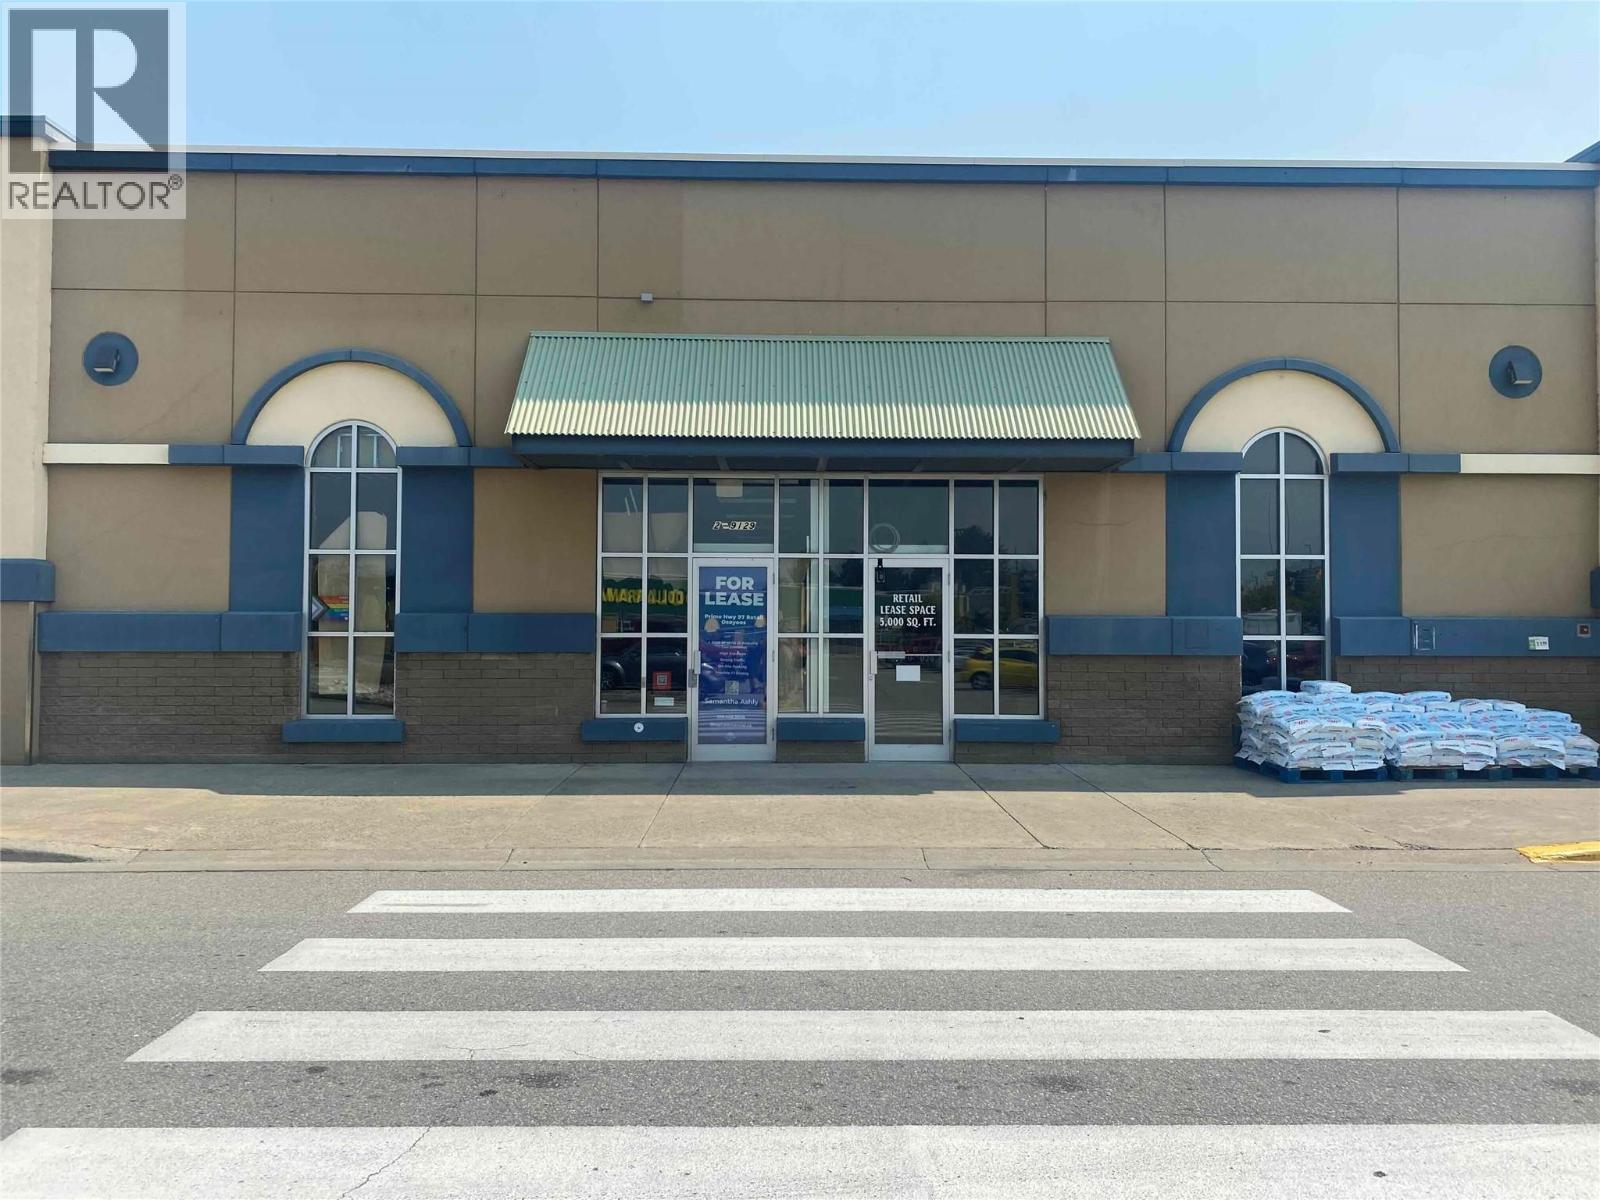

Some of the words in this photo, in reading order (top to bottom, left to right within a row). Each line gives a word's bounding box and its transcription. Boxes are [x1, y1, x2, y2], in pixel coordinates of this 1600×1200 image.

[712, 521, 757, 531] 2-9129
[715, 576, 754, 591] FOR
[704, 591, 765, 607] LEASE
[892, 593, 923, 603] RETAIL
[880, 605, 907, 615] LEASE
[909, 605, 937, 615] SPACE
[879, 617, 904, 628] 5,000
[906, 617, 921, 628] SQ.
[923, 617, 937, 627] FT.
[704, 697, 739, 705] Samantha
